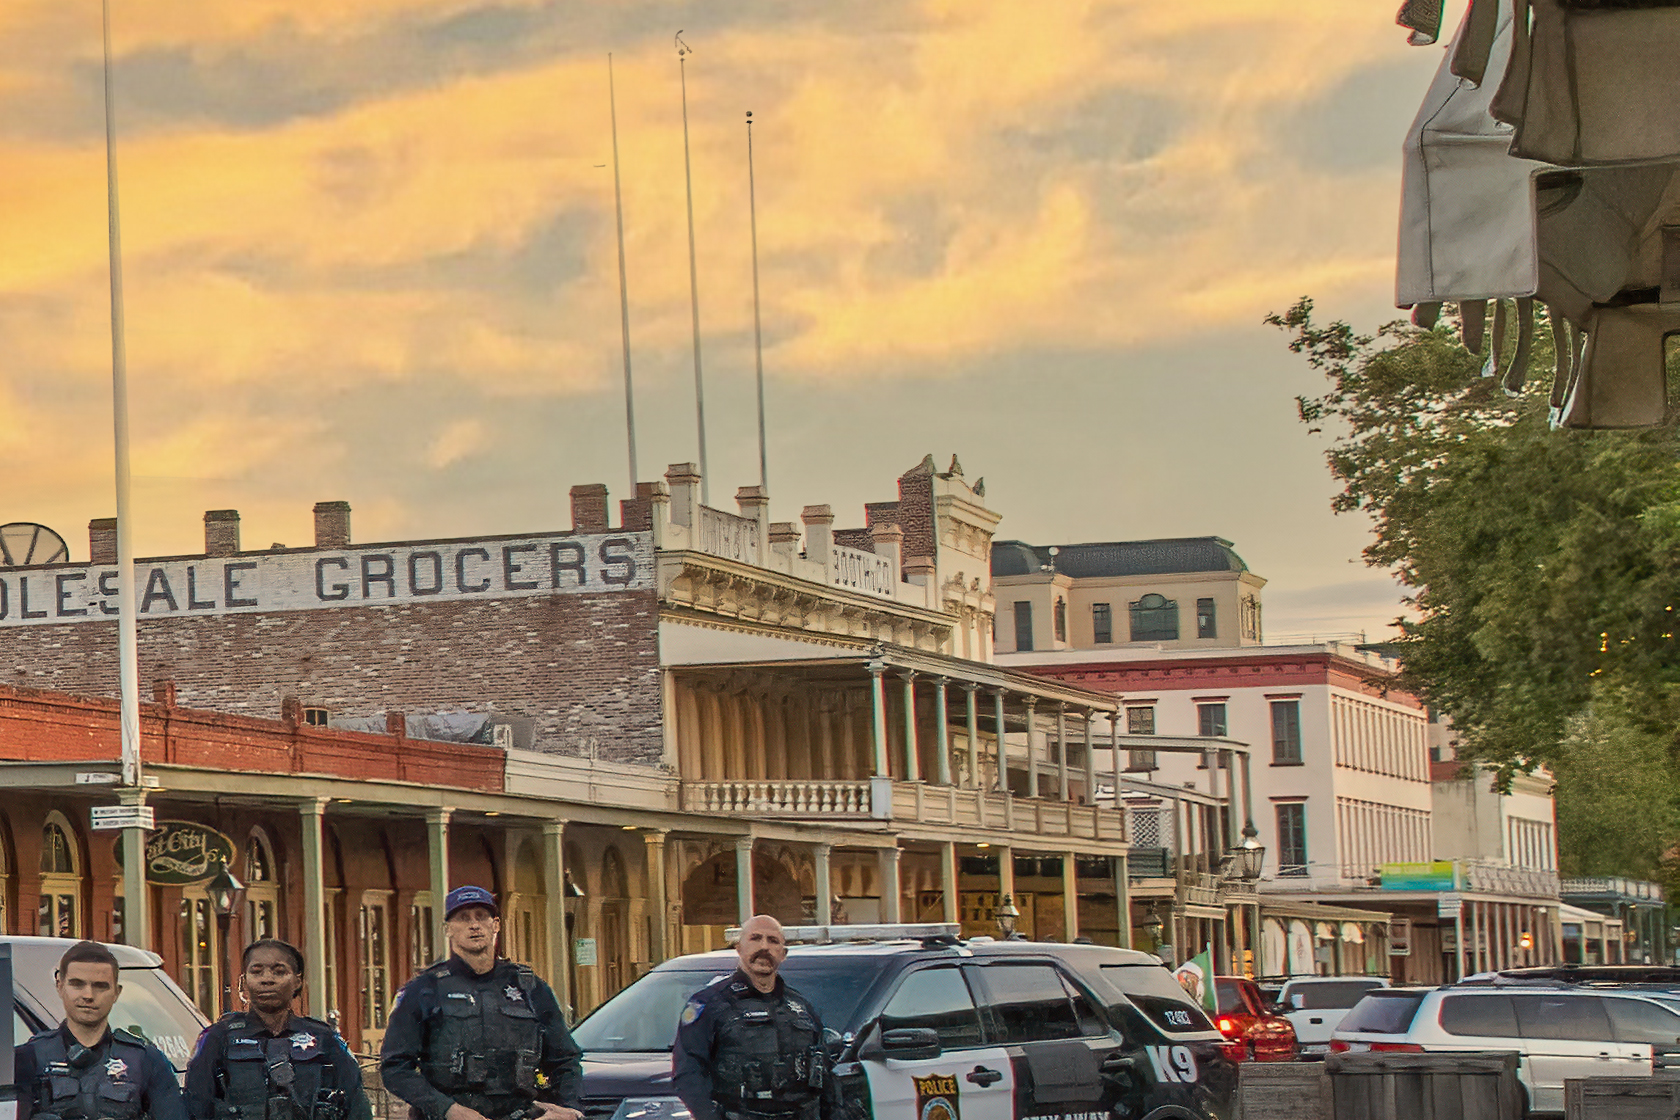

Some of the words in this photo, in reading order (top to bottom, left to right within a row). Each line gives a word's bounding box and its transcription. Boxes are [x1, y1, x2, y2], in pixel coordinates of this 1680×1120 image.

[314, 537, 638, 602] GROCERS
[1146, 1045, 1198, 1083] K9
[919, 1080, 957, 1096] POLICE
